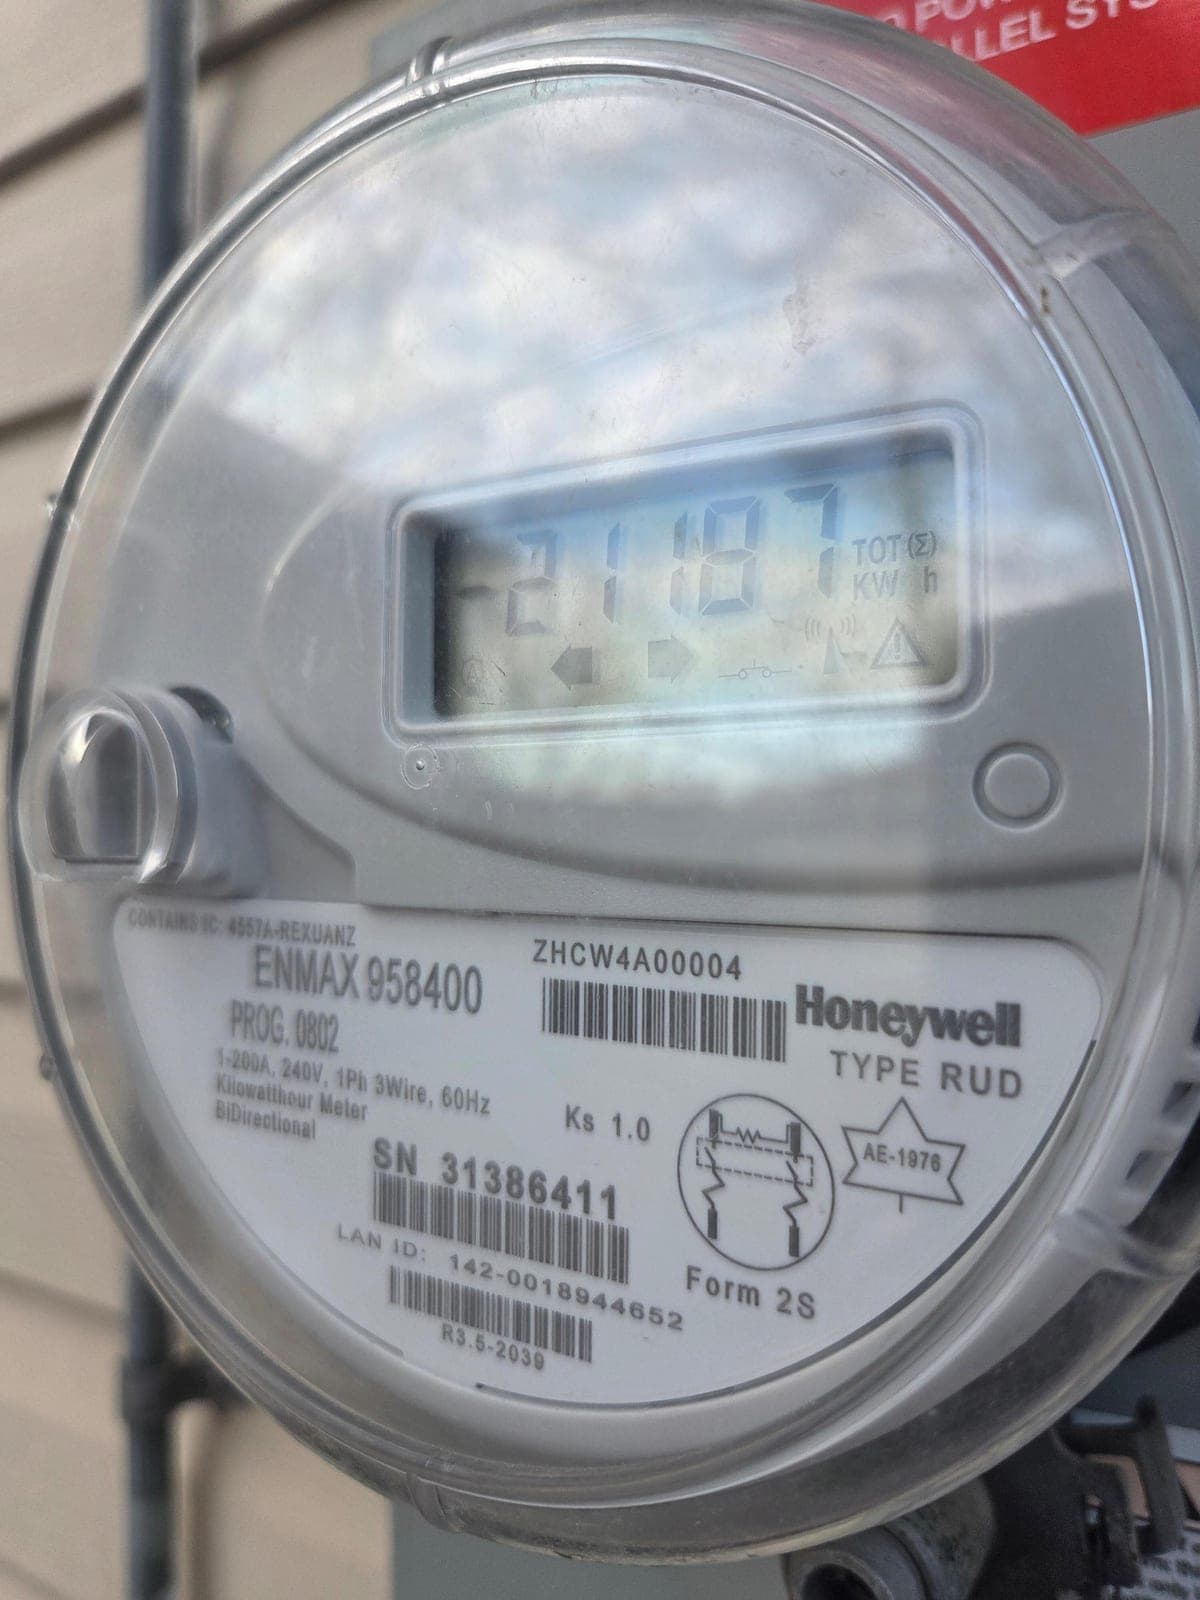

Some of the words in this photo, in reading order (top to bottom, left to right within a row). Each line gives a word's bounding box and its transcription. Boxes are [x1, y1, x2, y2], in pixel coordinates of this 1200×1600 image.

[254, 943, 361, 1000] ENMAX
[367, 955, 484, 1015] 958400
[533, 938, 742, 981] ZHCW4A00004
[231, 999, 290, 1046] PROG.
[296, 1008, 340, 1054] 0802
[795, 983, 1022, 1048] Honeywell
[216, 1073, 314, 1111] Kilowatthour
[320, 1091, 368, 1121] Meter
[336, 1066, 368, 1093] 1Ph
[375, 1073, 433, 1109] 3Wire,
[441, 1083, 491, 1115] 60Hz
[829, 1050, 920, 1087] TYPE
[940, 1062, 1023, 1100] RUD
[565, 1104, 595, 1133] Ks
[611, 1113, 651, 1142] 1.0
[373, 1137, 418, 1176] SN
[441, 1151, 616, 1220] 31386411
[863, 1142, 942, 1173] AE-1976
[336, 1222, 382, 1250] LAN
[394, 1238, 426, 1263] ID:
[449, 1253, 684, 1331] 142-0018944652
[686, 1265, 762, 1309] Form
[776, 1286, 817, 1321] 2S
[441, 1323, 546, 1371] R3.5-2039
